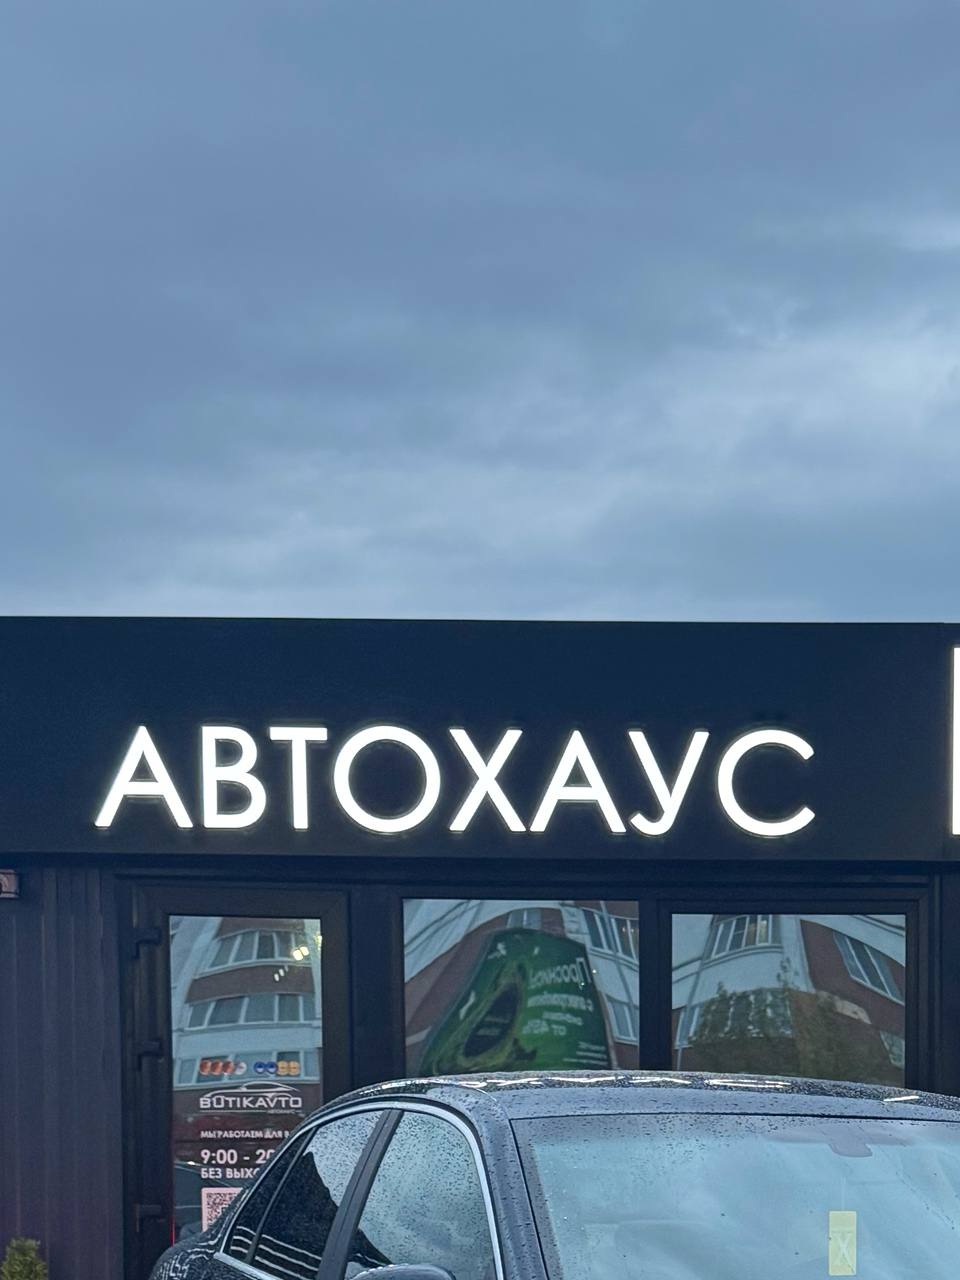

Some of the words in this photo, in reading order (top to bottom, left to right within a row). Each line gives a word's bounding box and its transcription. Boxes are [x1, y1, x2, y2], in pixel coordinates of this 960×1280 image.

[95, 725, 816, 838] АВТОХАУС
[199, 1096, 303, 1109] BUTIKAVTO
[218, 1130, 263, 1139] РАБОТАЕМ
[201, 1149, 238, 1165] 9:00
[201, 1167, 222, 1179] БЕЗ
